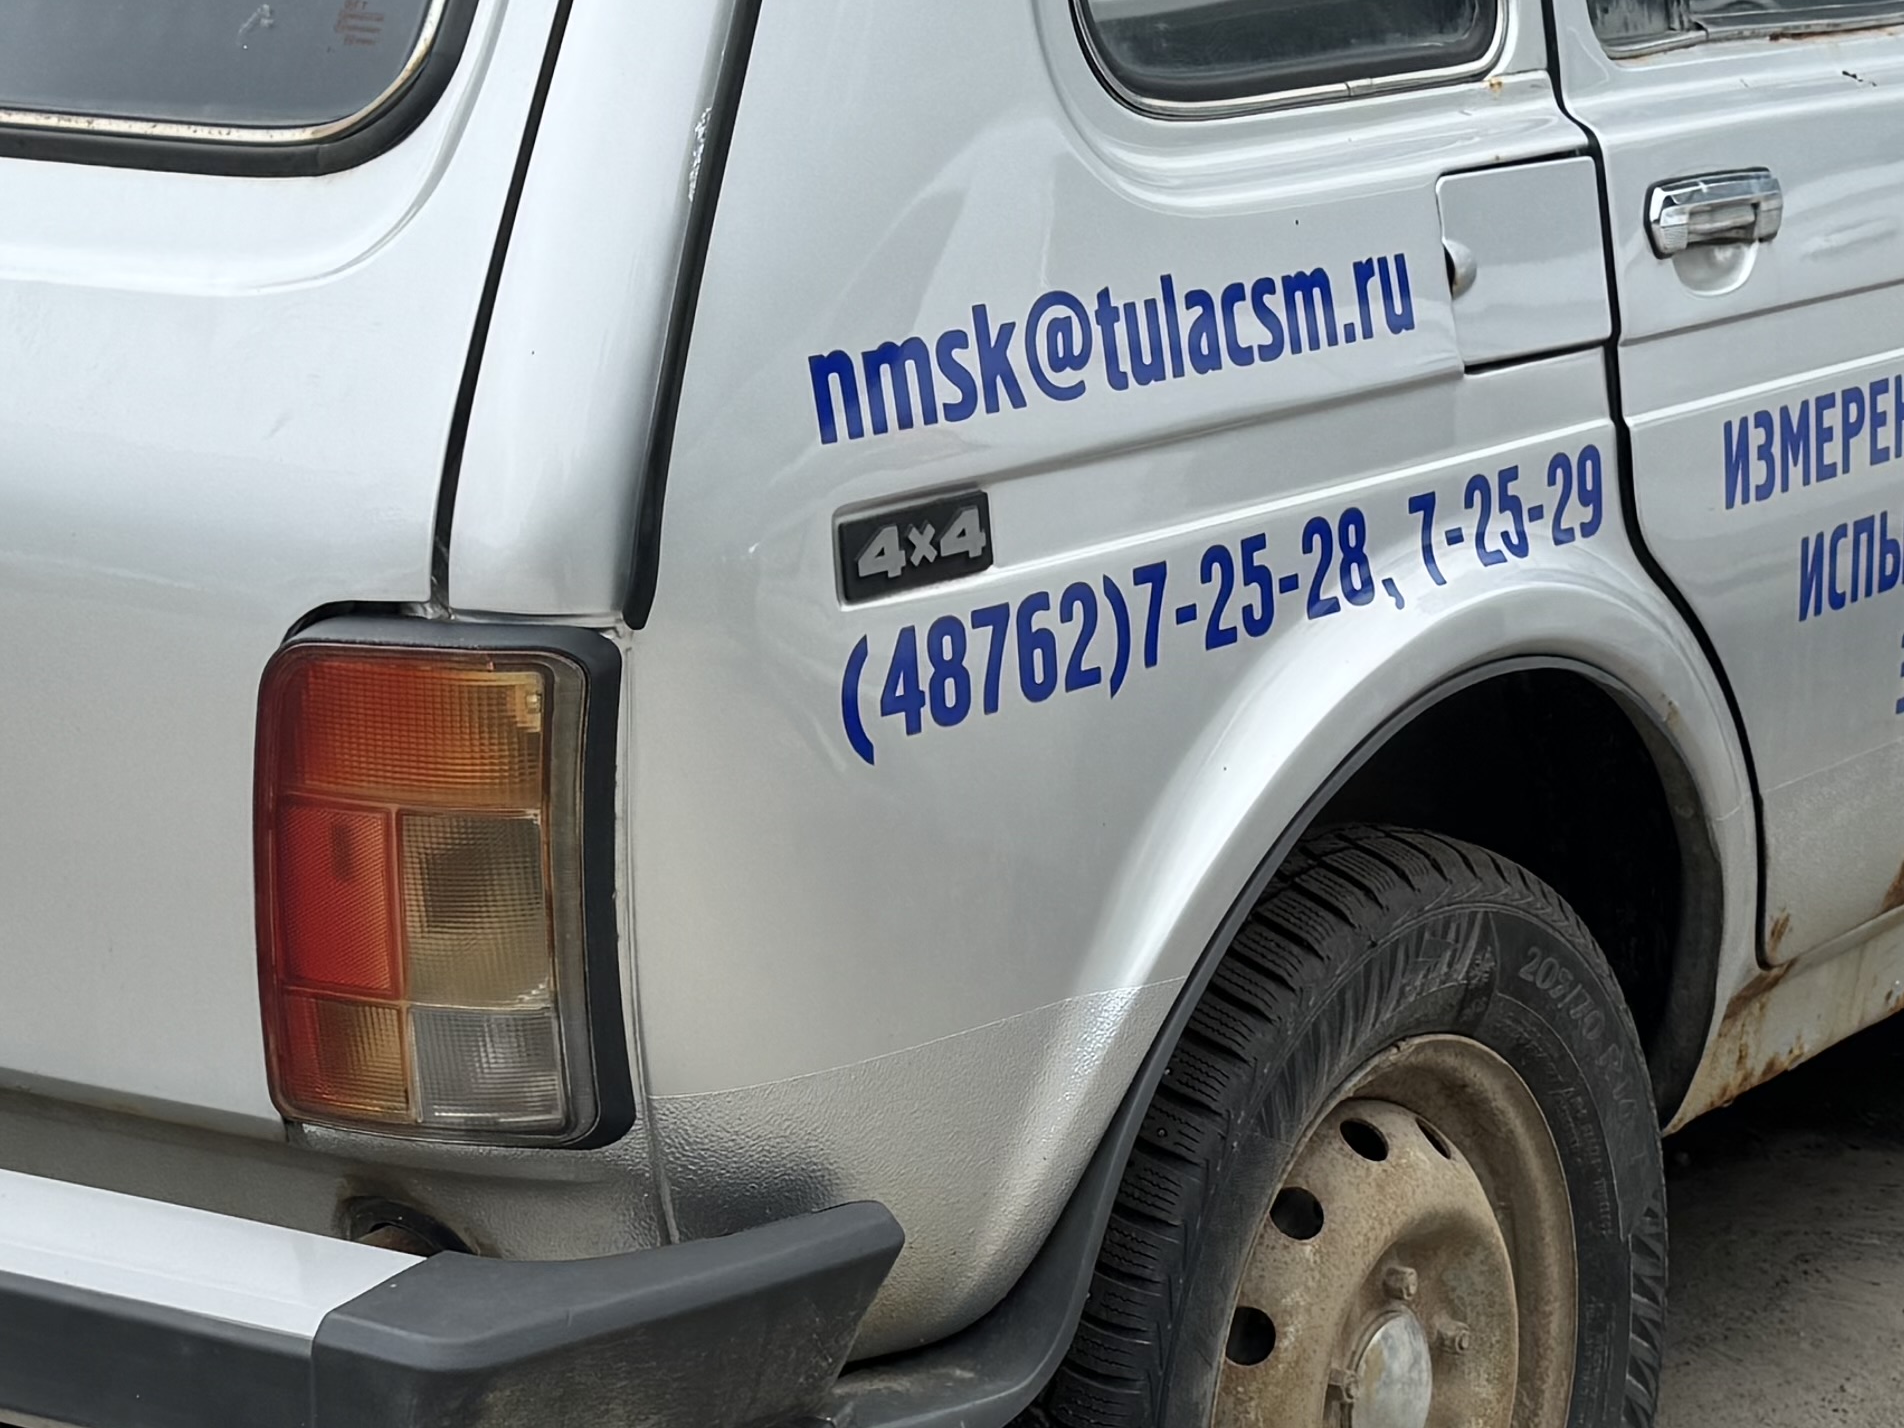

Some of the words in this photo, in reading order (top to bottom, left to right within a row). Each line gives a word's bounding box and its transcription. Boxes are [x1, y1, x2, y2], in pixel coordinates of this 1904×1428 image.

[808, 253, 1416, 445] nmsk@tulacsm.ru
[841, 507, 1405, 765] (48762)7-25-28,
[1407, 445, 1604, 587] 7-25-29
